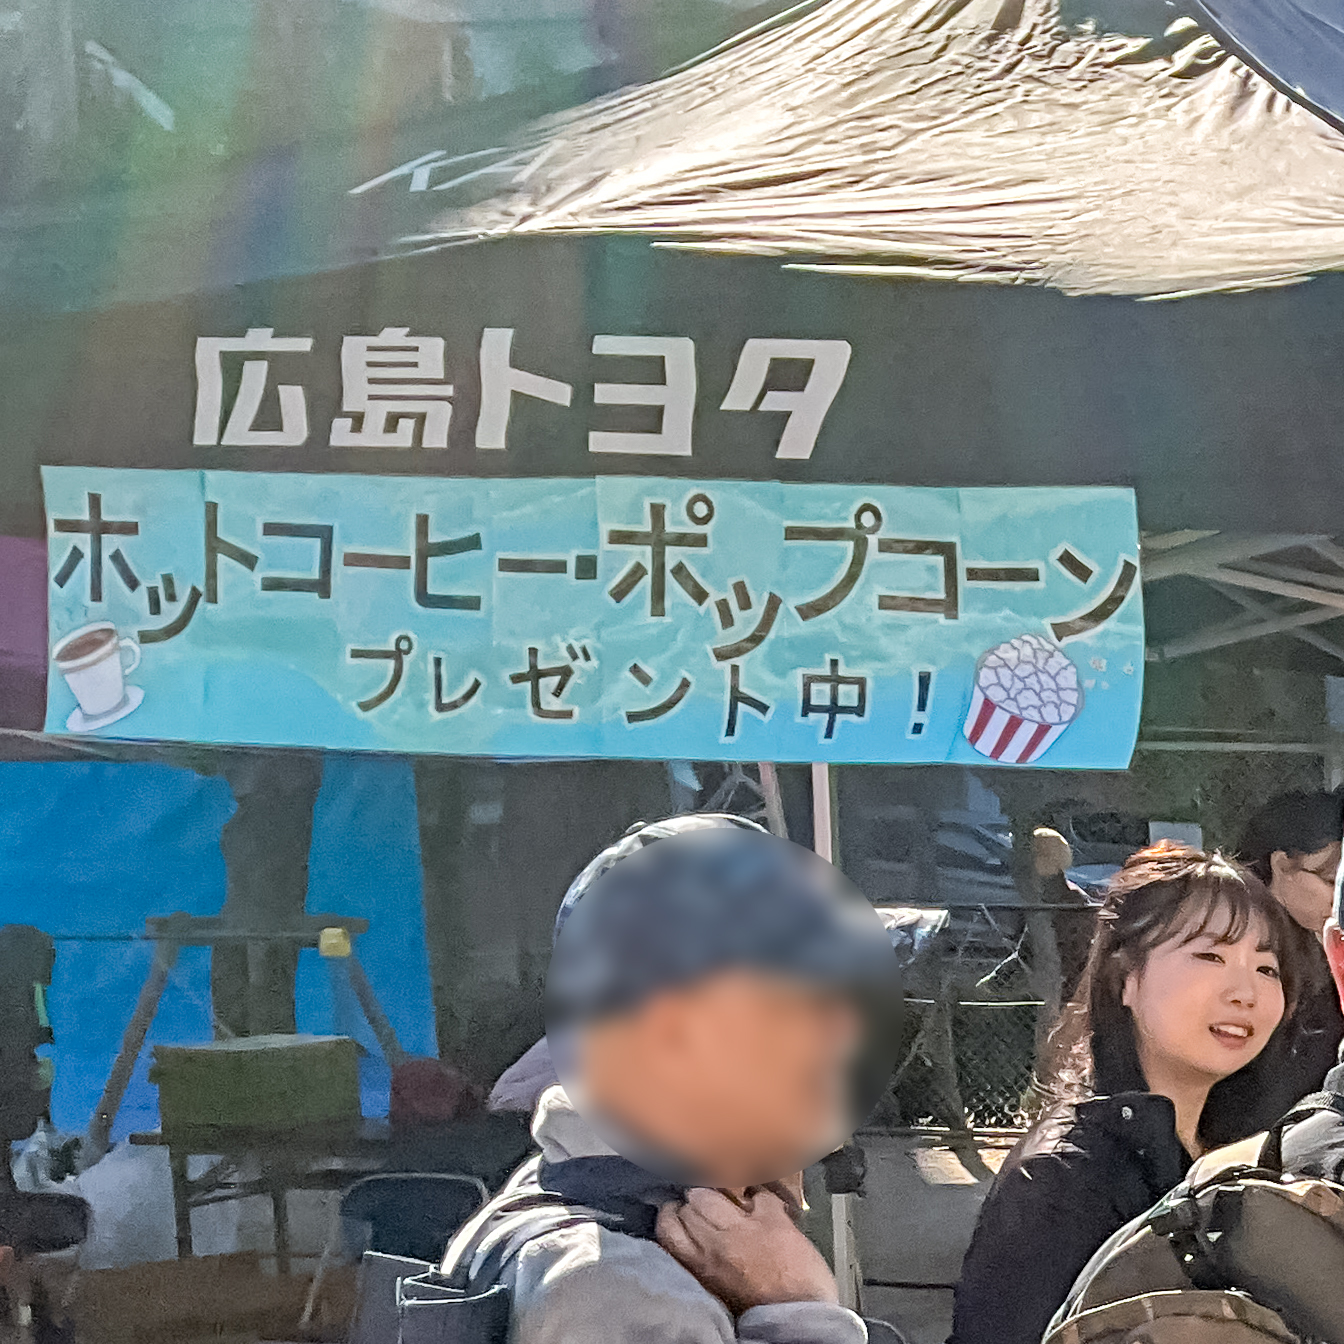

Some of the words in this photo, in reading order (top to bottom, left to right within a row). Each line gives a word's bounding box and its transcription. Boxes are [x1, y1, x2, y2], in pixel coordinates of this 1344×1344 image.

[193, 327, 852, 460] 広島トヨタ
[350, 634, 931, 740] プレゼント中！
